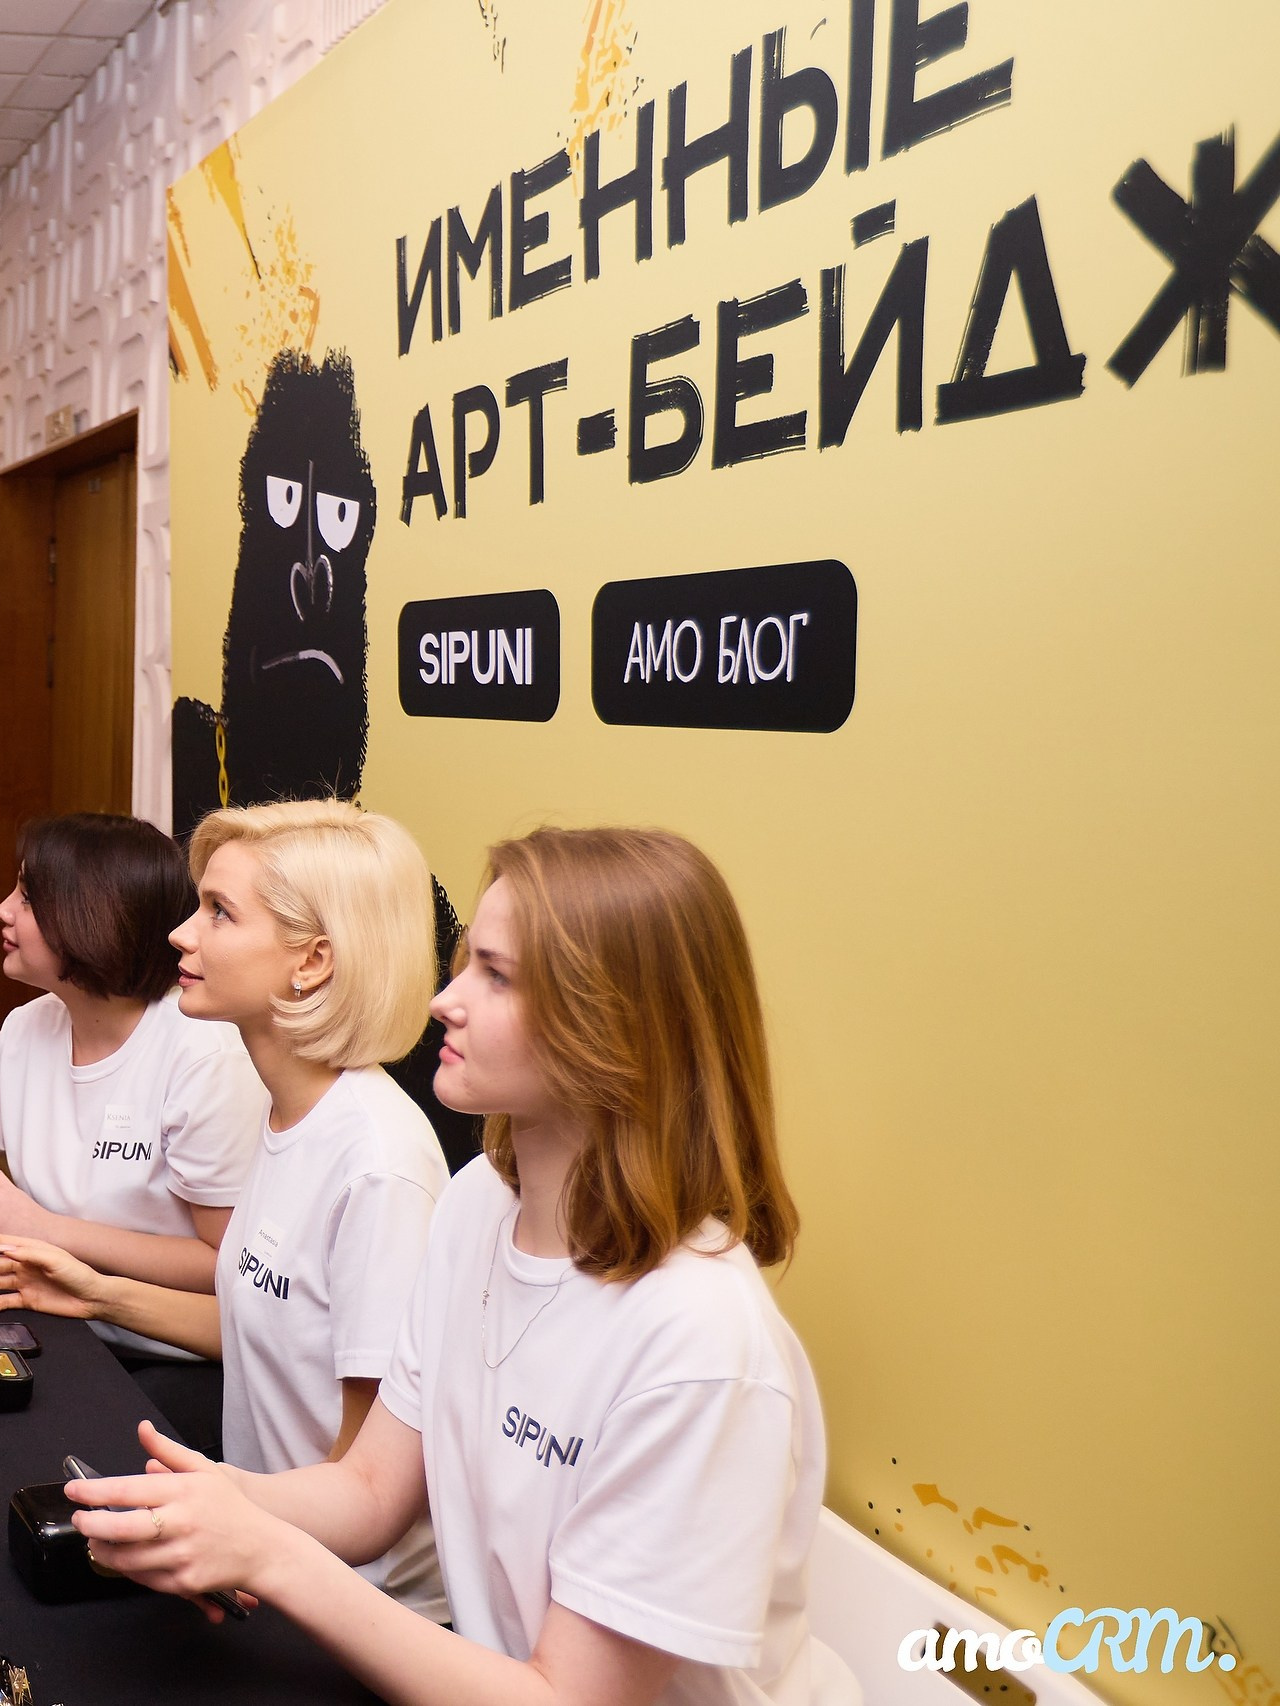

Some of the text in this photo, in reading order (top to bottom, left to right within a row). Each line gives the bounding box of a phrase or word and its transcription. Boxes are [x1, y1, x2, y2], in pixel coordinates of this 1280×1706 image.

[395, 0, 1015, 357] ИМЕННЫЕ
[399, 123, 1280, 526] АРТ-БЕЙДЖ
[419, 628, 532, 685] SIPUNI
[623, 612, 809, 685] АМО БЛОГ
[238, 1247, 291, 1300] SIPUNI
[501, 1405, 584, 1468] SIPUNI
